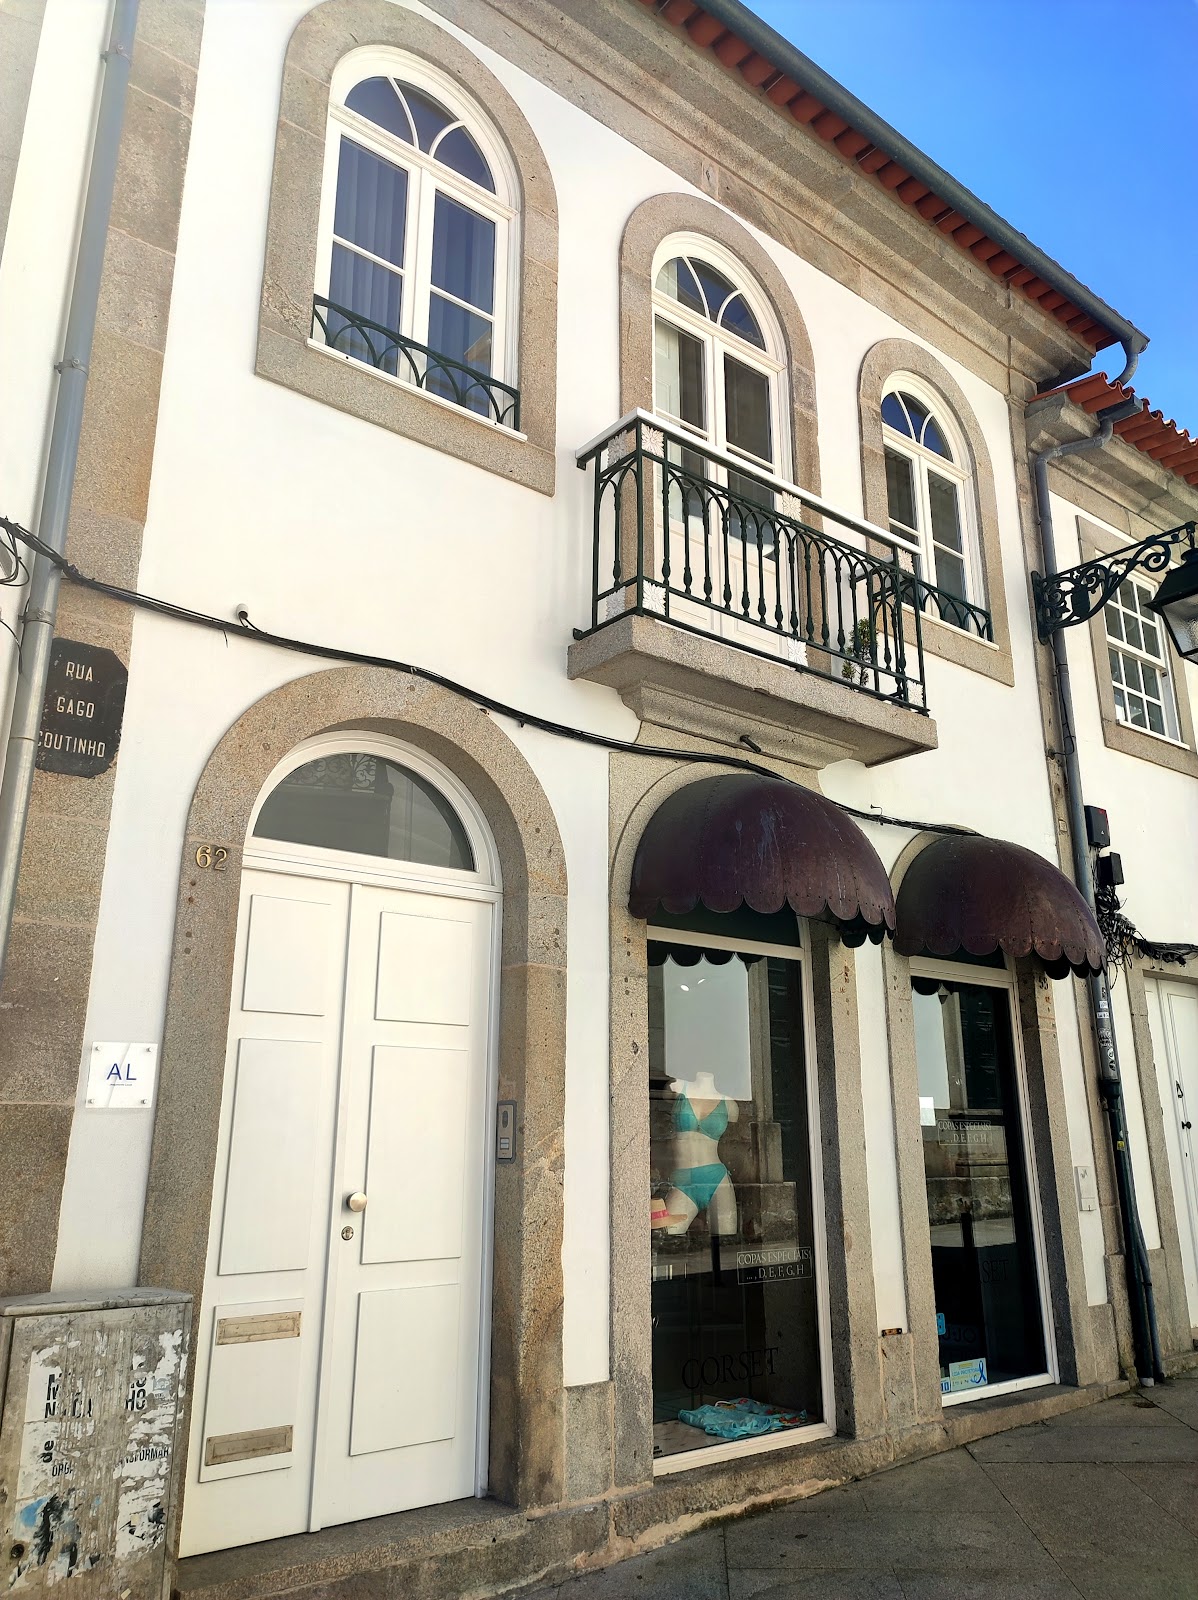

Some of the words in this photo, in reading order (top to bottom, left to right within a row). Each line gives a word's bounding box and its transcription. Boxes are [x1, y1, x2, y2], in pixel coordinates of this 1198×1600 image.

[66, 661, 94, 682] RUA
[56, 696, 95, 719] GAGO
[196, 844, 228, 871] 62
[106, 1062, 137, 1081] AL
[738, 1252, 767, 1265] COPAS
[796, 1264, 804, 1275] H
[681, 1346, 779, 1390] CORSET
